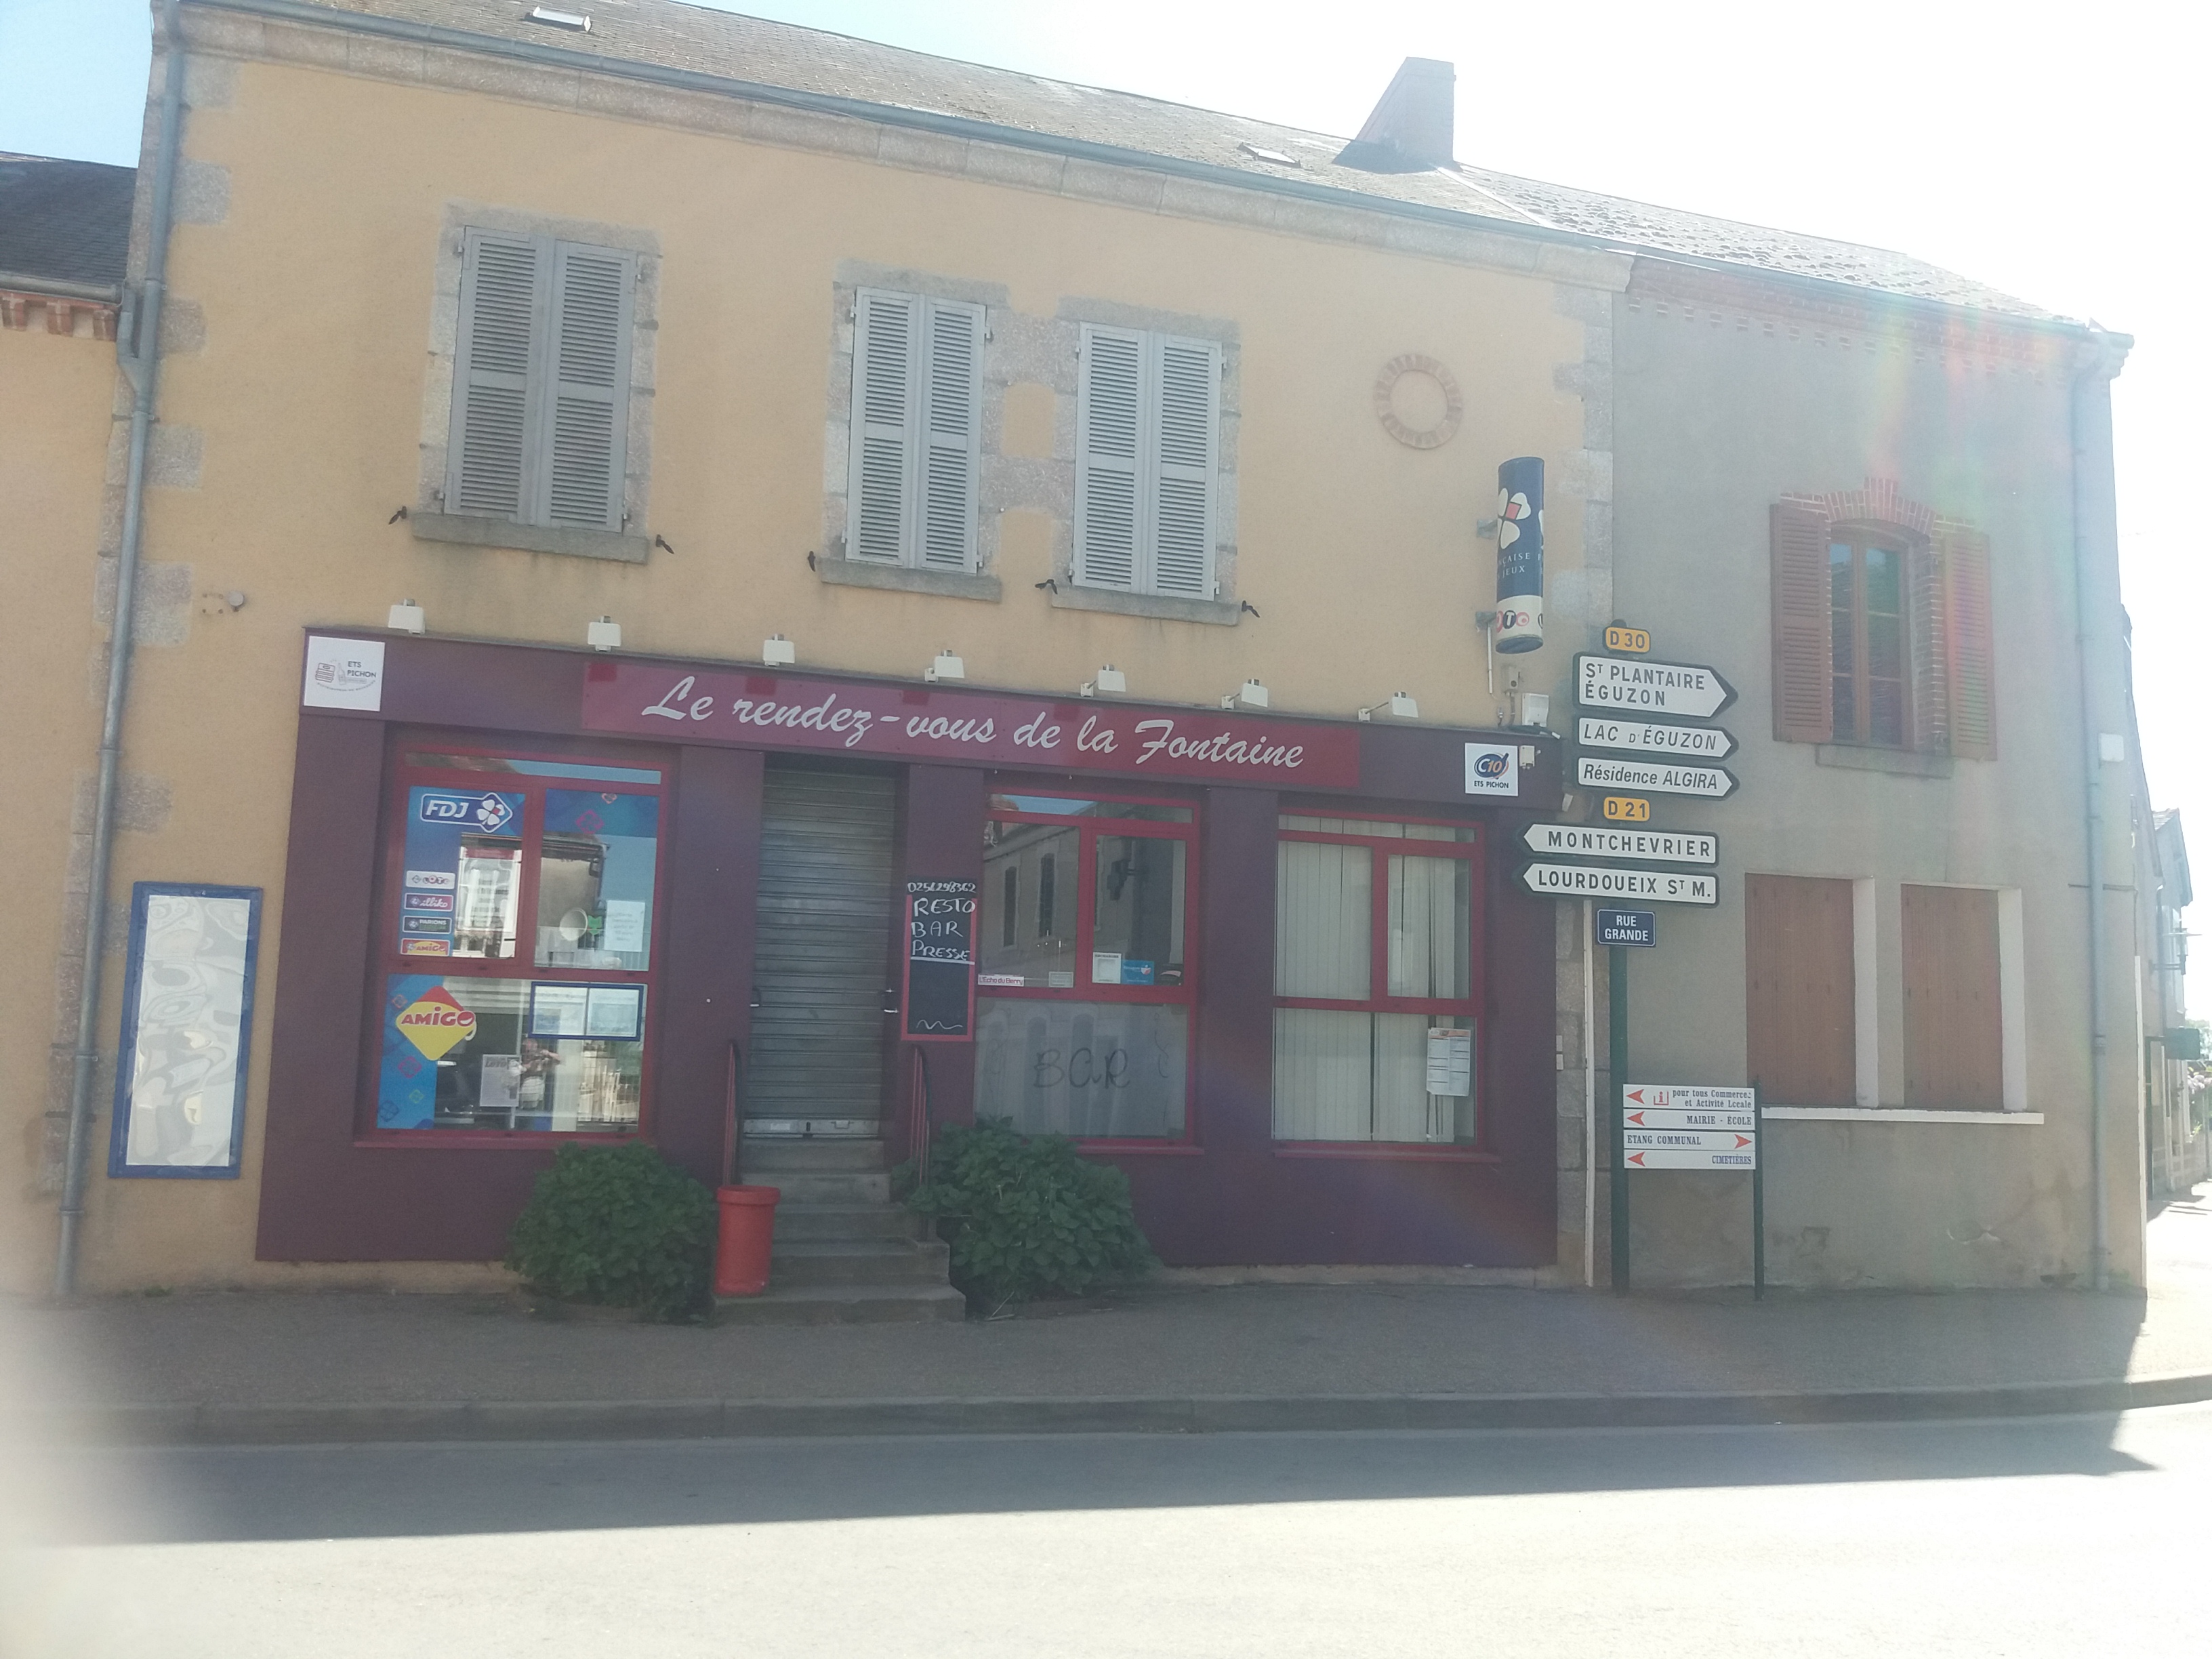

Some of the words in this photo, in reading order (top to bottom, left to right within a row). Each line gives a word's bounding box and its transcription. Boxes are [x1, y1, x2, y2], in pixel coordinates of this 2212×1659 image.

[1502, 565, 1525, 579] JEUX
[1610, 630, 1620, 646] D
[1624, 632, 1645, 649] 30
[347, 670, 377, 678] PICHON
[1610, 665, 1704, 690] PLANTAIRE
[1585, 680, 1665, 706] ÉGUZON
[641, 676, 714, 721] Le
[732, 693, 997, 747] rendez-vous
[1013, 711, 1061, 749] de
[1077, 715, 1119, 754] la
[1135, 719, 1304, 768] Fontaine
[1584, 724, 1618, 741] LAC
[1478, 758, 1502, 773] C10
[1584, 764, 1658, 785] Résidence
[1662, 771, 1718, 790] ALGIRA
[426, 800, 470, 819] FDJ
[1608, 800, 1618, 816] D
[1625, 802, 1646, 819] 21
[1548, 831, 1711, 857] MONTCHEVRIER
[1538, 870, 1657, 894] LOURDOUEIX
[1692, 882, 1711, 898] M.
[914, 897, 976, 917] RESTO
[911, 920, 964, 938] BAR
[1616, 915, 1637, 927] RUE
[1604, 928, 1649, 941] GRANDE
[912, 939, 970, 961] PRESSE
[401, 1006, 475, 1027] AMIGO
[1673, 1090, 1689, 1098] pour
[1696, 1099, 1724, 1107] Activité
[1687, 1115, 1716, 1125] MAIRIE
[1627, 1134, 1653, 1144] ETANG
[1657, 1136, 1702, 1145] COMMUNAL
[1712, 1153, 1752, 1164] CIMETIÈRES
